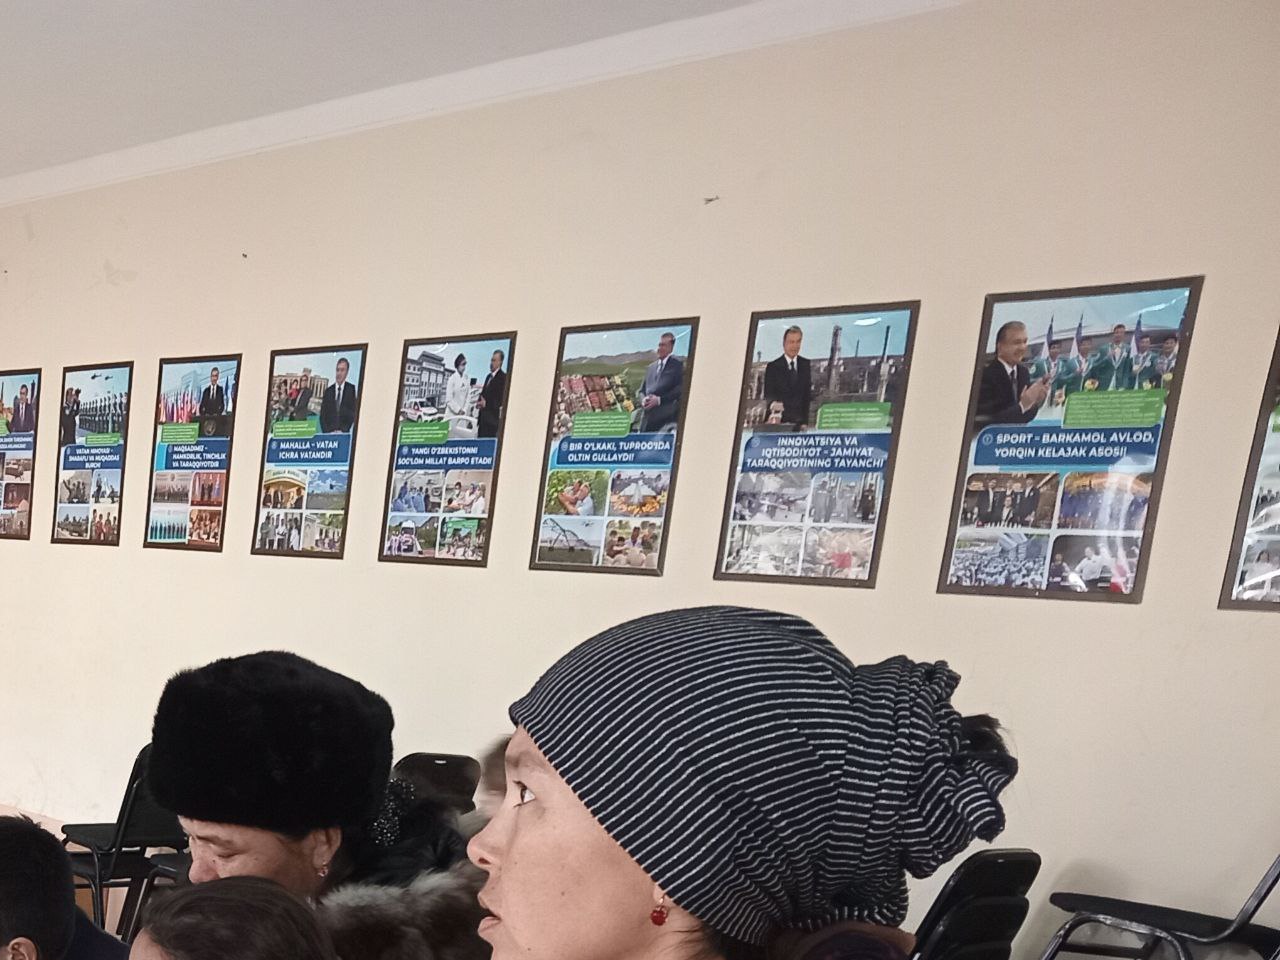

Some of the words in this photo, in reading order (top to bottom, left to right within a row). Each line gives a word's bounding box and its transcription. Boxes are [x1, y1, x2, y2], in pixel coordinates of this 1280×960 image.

[778, 436, 841, 447] INNOVATSIYA
[844, 436, 858, 446] VA
[997, 433, 1033, 444] SPORT
[1042, 432, 1106, 444] BARKAMOL
[1110, 431, 1154, 444] AVLOD,
[569, 442, 582, 451] BIR
[568, 453, 591, 462] OLTIN
[762, 447, 821, 458] IQTISODIYOT
[830, 447, 874, 457] JAMIYAT
[995, 447, 1035, 459] YORQIN
[1038, 446, 1086, 458] KELAJAK
[747, 458, 832, 469] TARAQQIYOTINING
